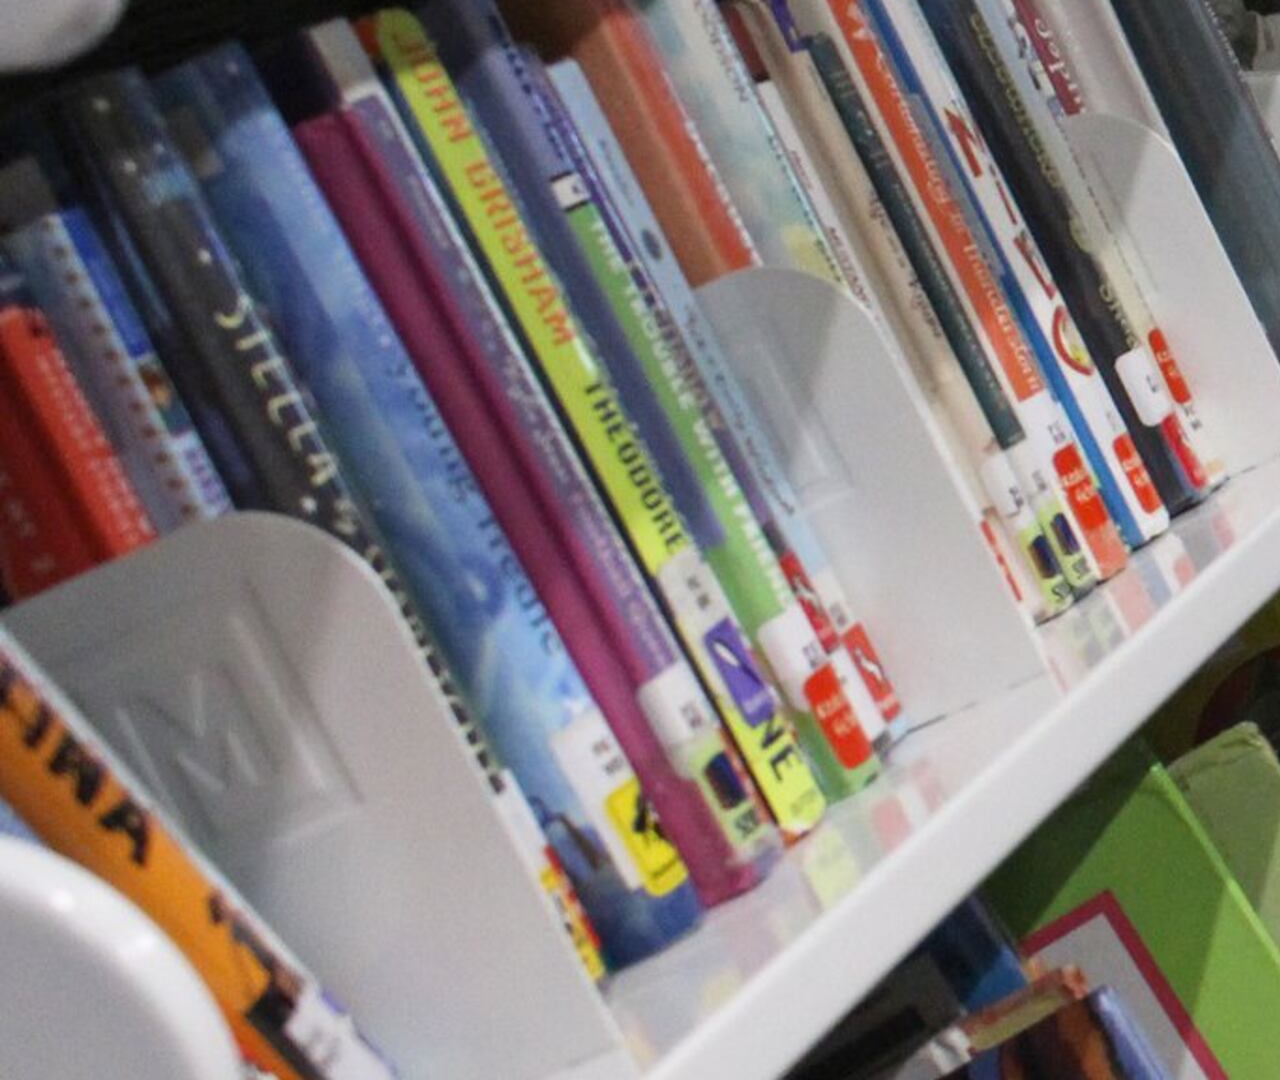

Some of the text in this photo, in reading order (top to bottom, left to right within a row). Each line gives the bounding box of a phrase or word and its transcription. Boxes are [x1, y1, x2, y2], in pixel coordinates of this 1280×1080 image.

[208, 289, 347, 493] STELLA
[451, 155, 587, 352] GRISHAM
[571, 374, 698, 559] THEODORE
[583, 215, 630, 278] THE
[614, 280, 702, 414] TROUBLE
[685, 415, 745, 501] WITH
[955, 239, 1051, 394] Thunderstorm
